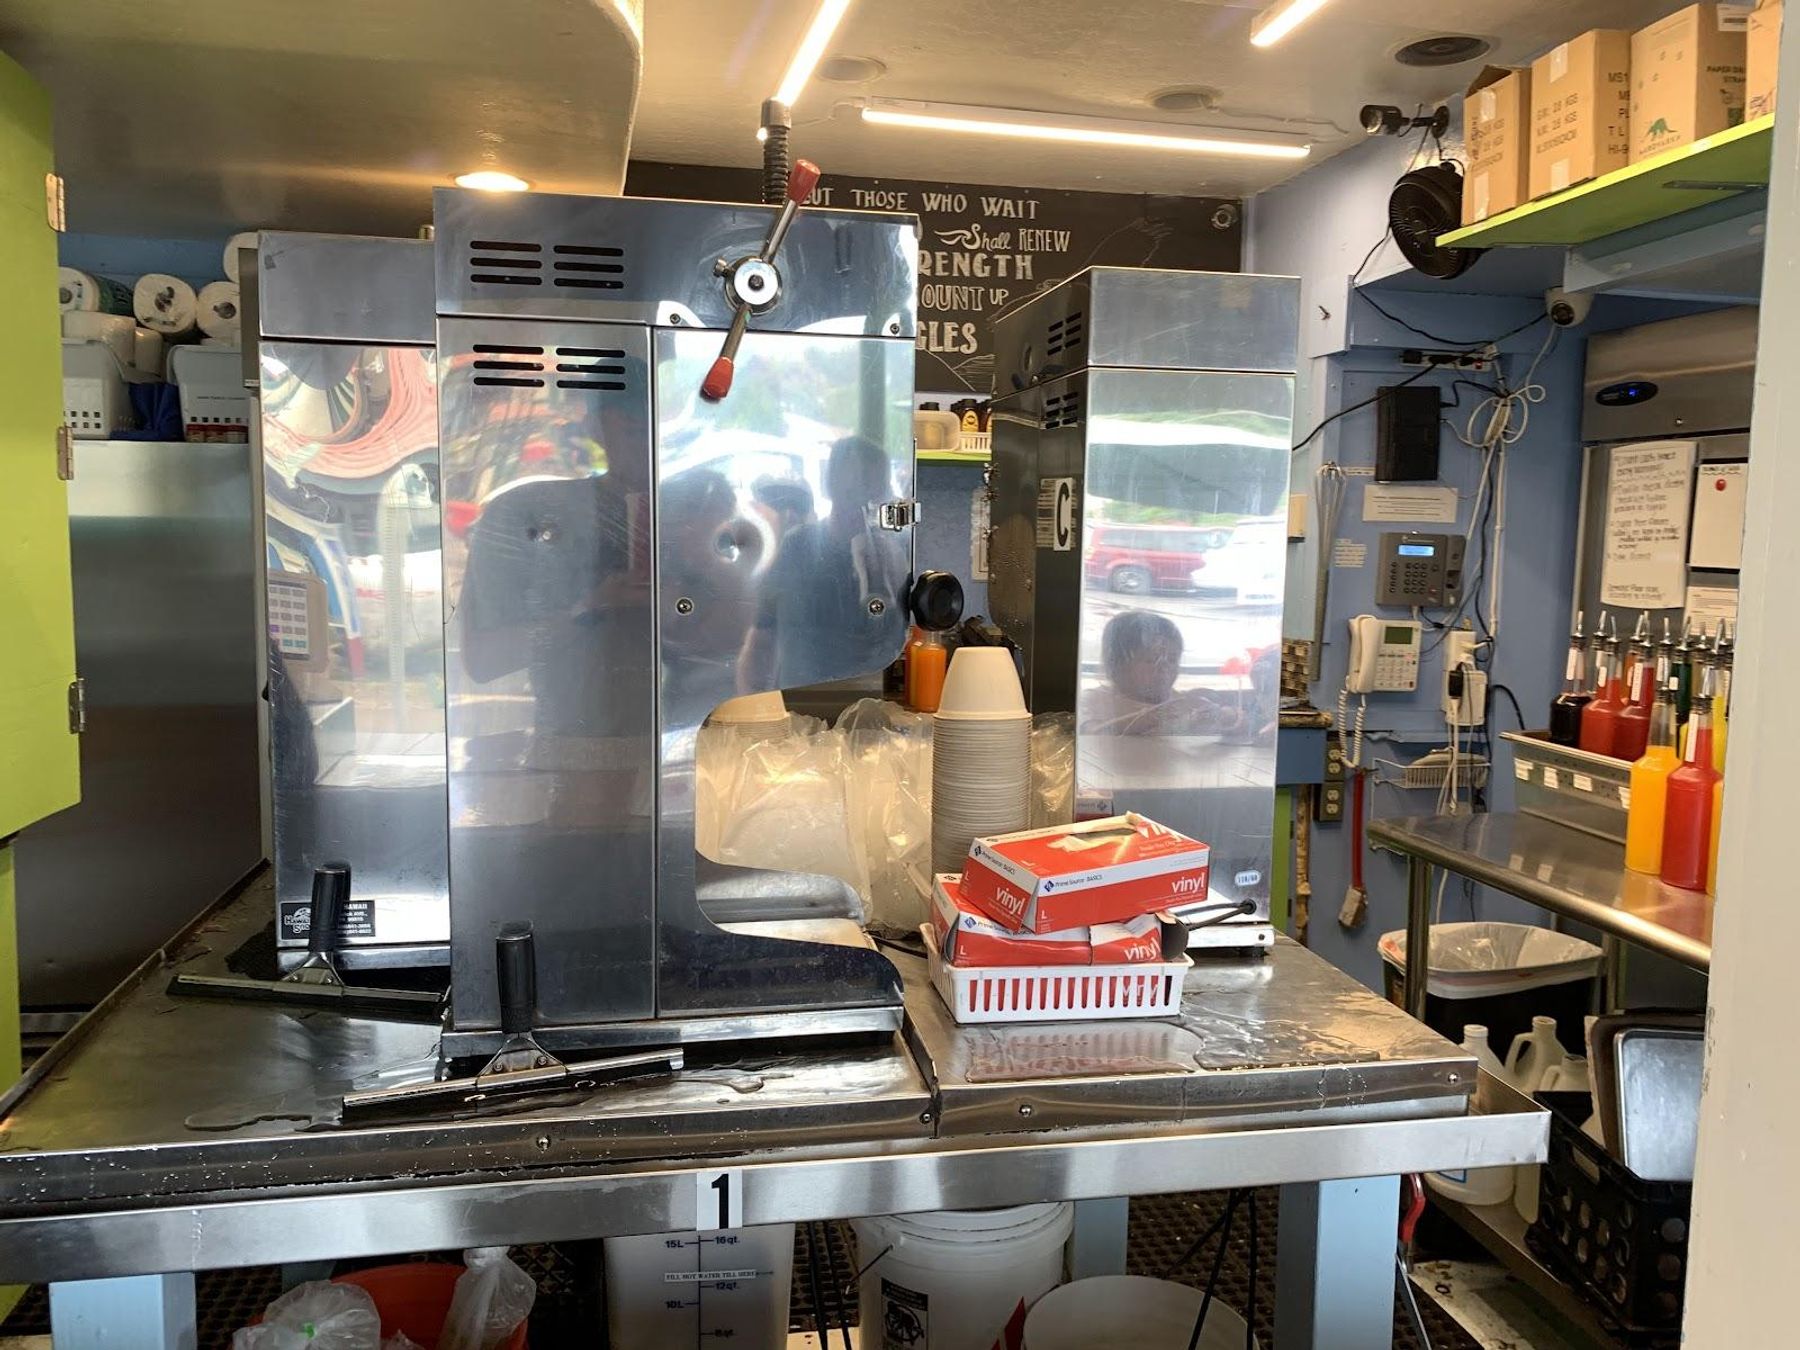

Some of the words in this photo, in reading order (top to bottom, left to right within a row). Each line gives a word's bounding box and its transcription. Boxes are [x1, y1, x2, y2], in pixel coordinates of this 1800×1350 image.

[850, 189, 908, 210] THOSE
[922, 192, 967, 213] WHO
[980, 197, 1040, 219] WAIT
[961, 223, 1011, 251] Shall
[1019, 228, 1070, 252] RENEW
[990, 288, 1009, 306] UP
[1172, 872, 1206, 894] vinyl
[996, 886, 1026, 916] vinyl
[1041, 909, 1048, 920] L
[960, 944, 967, 956] L
[1124, 938, 1162, 961] vinyl
[711, 1173, 730, 1230] 1
[666, 1240, 684, 1249] 15L
